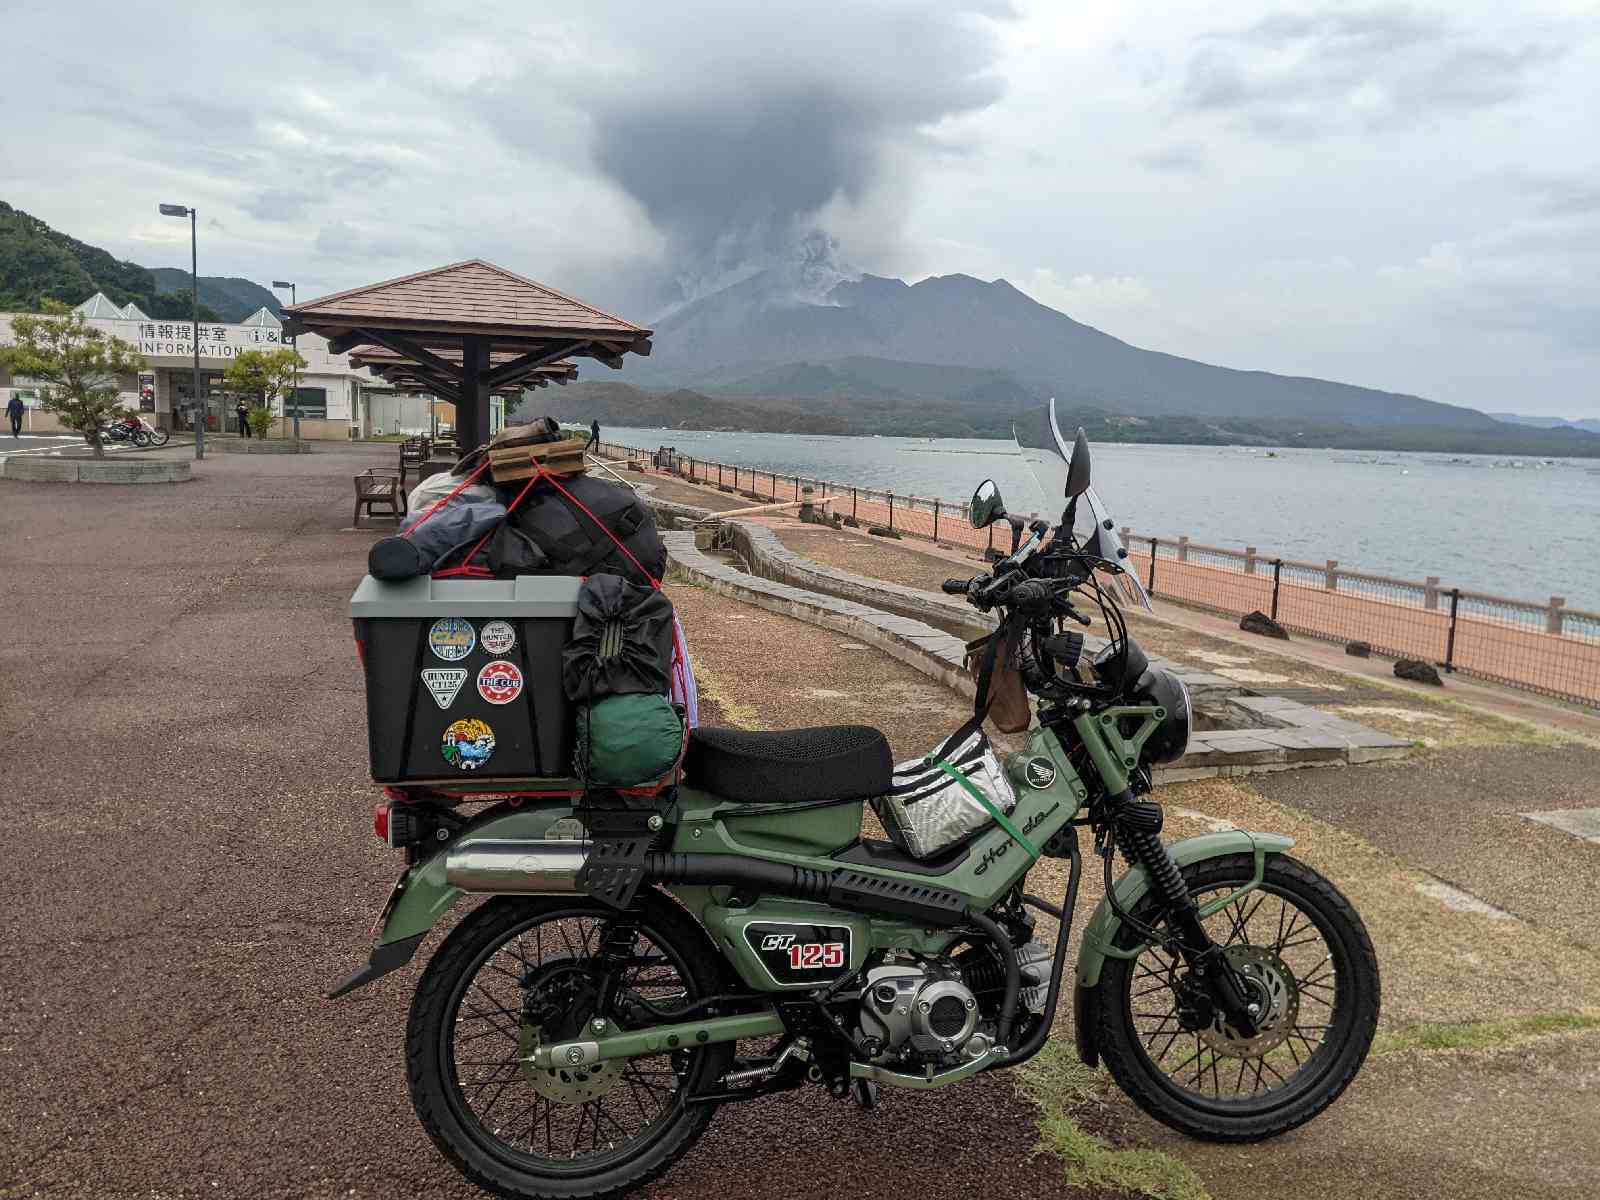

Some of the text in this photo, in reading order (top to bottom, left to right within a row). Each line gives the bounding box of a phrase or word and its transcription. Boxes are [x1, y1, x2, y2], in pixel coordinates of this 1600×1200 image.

[138, 341, 243, 358] INFORMATION
[427, 672, 462, 680] HUNTER
[482, 678, 520, 688] THE CUB
[761, 934, 796, 951] CT
[787, 943, 844, 969] 125
